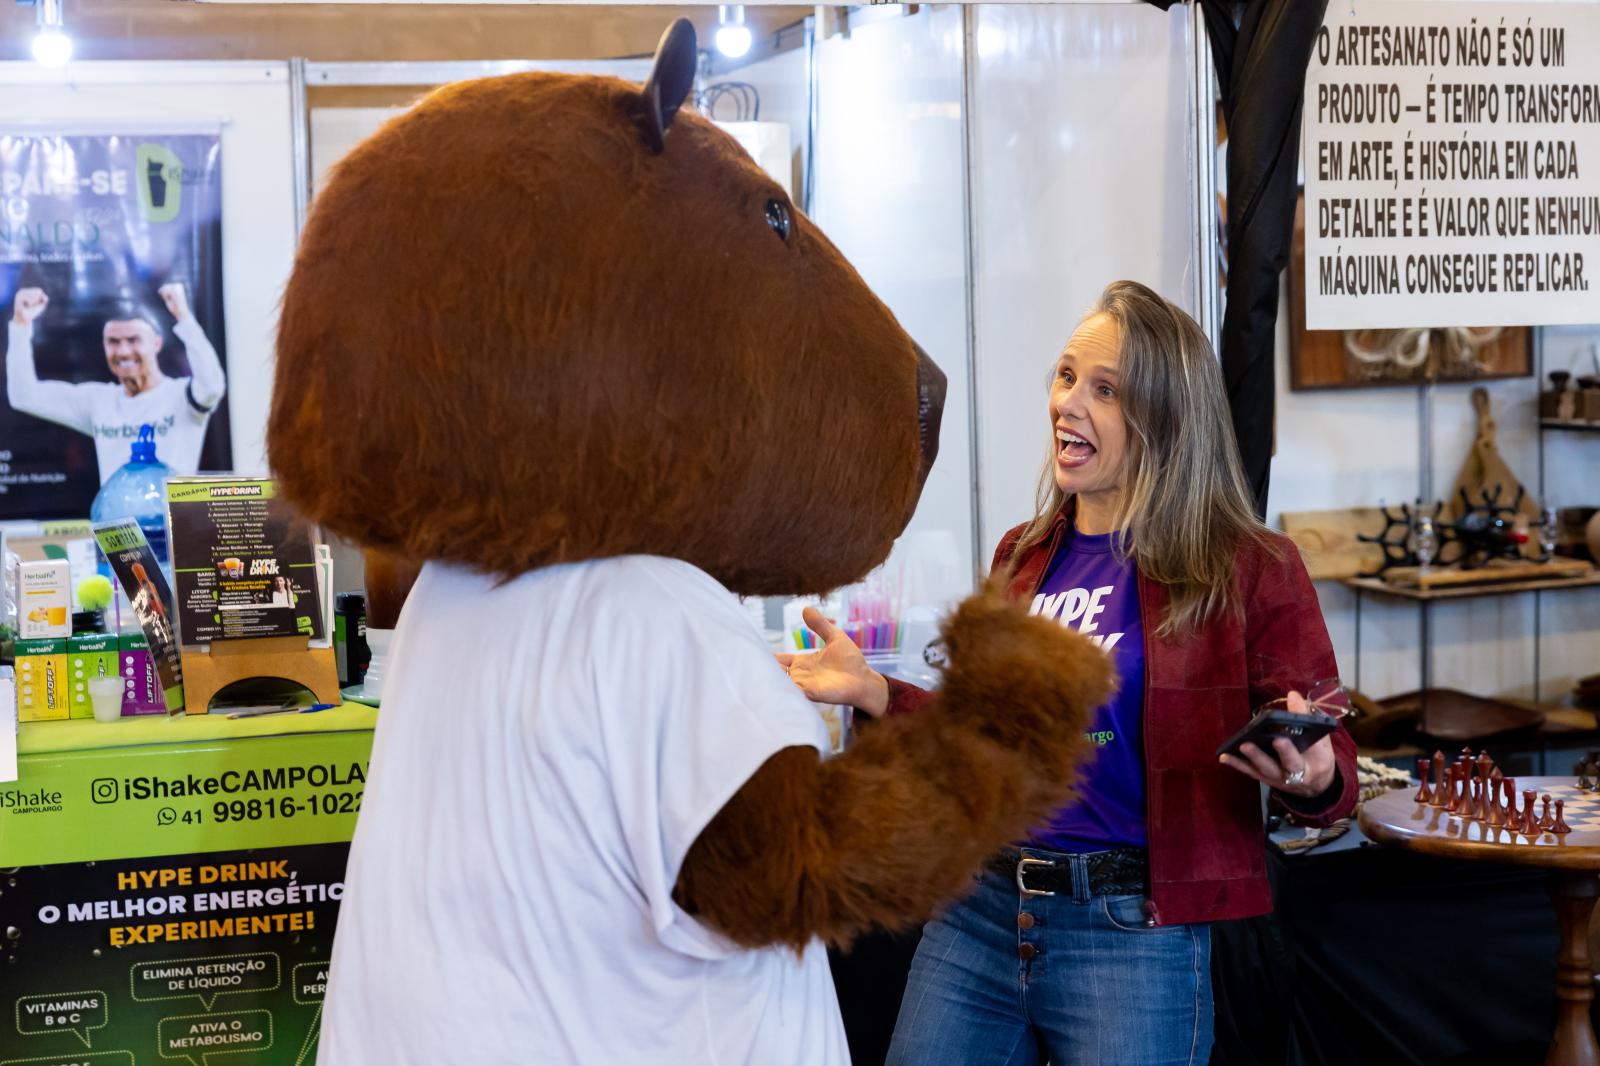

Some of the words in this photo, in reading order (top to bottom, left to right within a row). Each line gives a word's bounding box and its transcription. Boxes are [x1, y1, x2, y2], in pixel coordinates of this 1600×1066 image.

[1319, 26, 1330, 66] O
[1336, 26, 1449, 66] ARTESANATO
[1456, 18, 1491, 66] NÃO
[1498, 18, 1506, 66] É
[1513, 18, 1534, 66] SÓ
[1540, 28, 1564, 66] UM
[1319, 83, 1400, 124] PRODUTO
[1426, 74, 1436, 123] É
[1442, 84, 1498, 124] TEMPO
[1319, 141, 1342, 180] EM
[1349, 141, 1398, 190] ARTE,
[1404, 130, 1414, 180] É
[1420, 130, 1499, 180] HISTÓRIA
[1506, 141, 1528, 180] EM
[1534, 140, 1578, 179] CADA
[1319, 198, 1396, 238] DETALHE
[1403, 198, 1412, 237] E
[1419, 188, 1428, 237] É
[1434, 197, 1489, 236] VALOR
[1496, 197, 1529, 238] QUE
[1320, 246, 1400, 298] MÁQUINA
[1406, 254, 1497, 294] CONSEGUE
[1504, 252, 1588, 292] REPLICAR.
[252, 559, 276, 568] HYPE
[1083, 731, 1114, 745] argo
[124, 762, 370, 800] iShakeCAMPOLA
[0, 788, 62, 808] iShake
[13, 806, 62, 814] CAMPOLARGO
[182, 809, 203, 826] 41
[118, 868, 192, 890] HYPE
[38, 904, 60, 924] O
[68, 895, 186, 922] MELHOR
[194, 880, 345, 912] ENERGÉTIC
[110, 911, 315, 946] EXPERIMENTE!
[143, 966, 193, 980] ELIMINA
[197, 960, 265, 976] RETENÇÃO
[168, 980, 185, 990] DE
[189, 975, 242, 990] LÍQUIDO
[26, 999, 98, 1014] VITAMINAS
[45, 1016, 54, 1026] B
[58, 1016, 67, 1024] e
[70, 1014, 80, 1023] C
[189, 1022, 228, 1034] ATIVA
[231, 1020, 242, 1030] O
[170, 1031, 263, 1048] METABOLISMO
